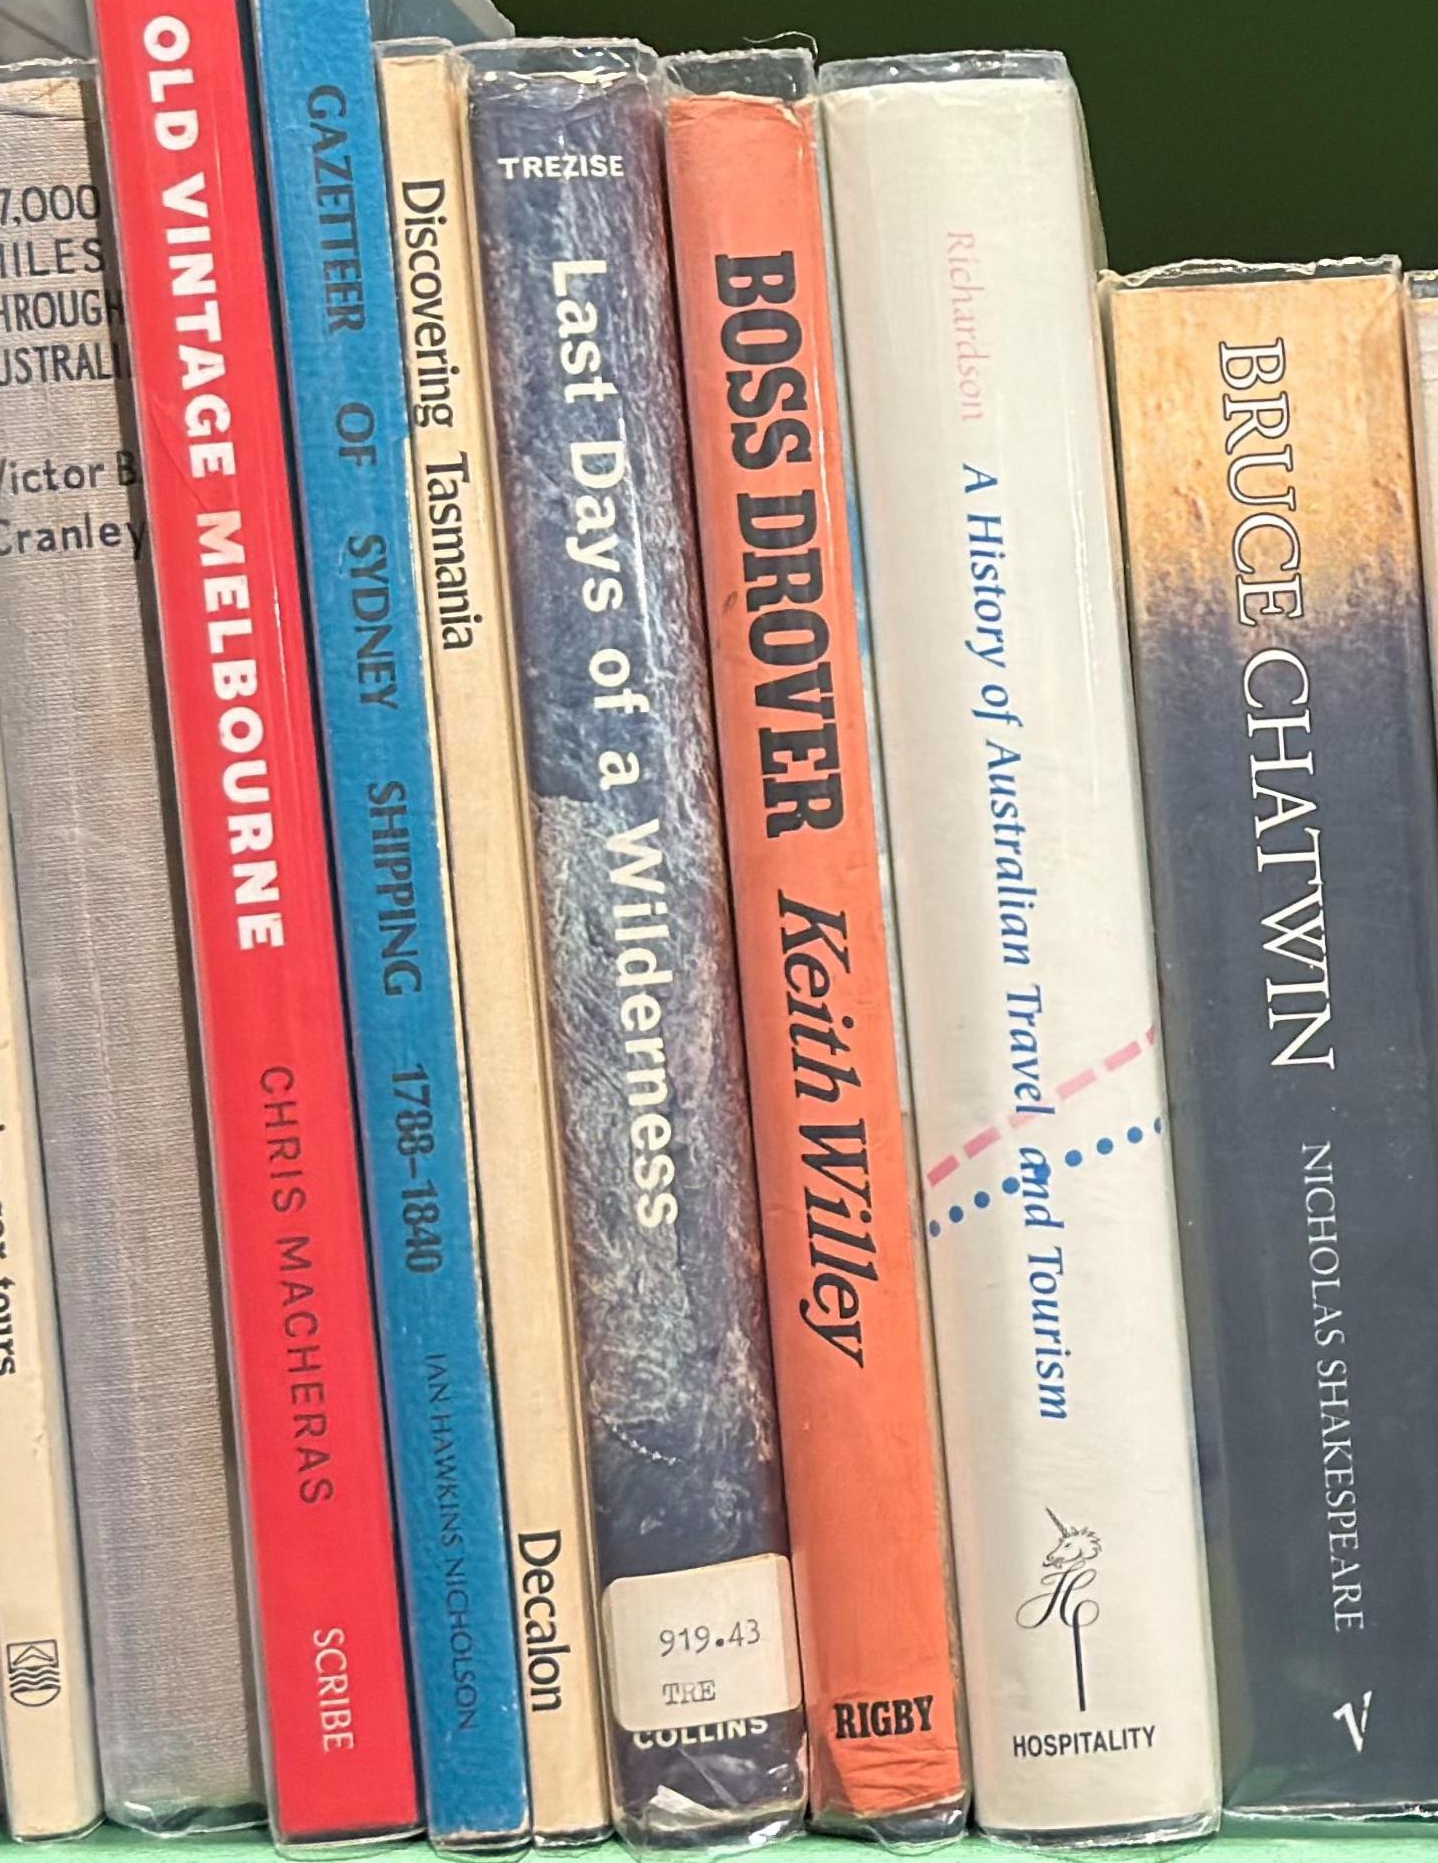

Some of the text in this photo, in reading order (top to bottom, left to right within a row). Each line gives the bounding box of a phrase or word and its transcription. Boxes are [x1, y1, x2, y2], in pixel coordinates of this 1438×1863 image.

[497, 154, 625, 181] TREZISE
[143, 14, 285, 952] OLD VINTAGE MELBOURNE
[306, 83, 424, 999] GAZETTEER OF SYDNEY SHIPPING
[401, 179, 483, 651] Discovering Tasmania
[551, 259, 680, 1231] Last Days of a Wilderness
[714, 250, 880, 1369] BOSS DROVER Keith Willey
[946, 231, 1070, 1421] Richardson A History of Australian Travel and Tourism
[1218, 336, 1336, 1071] BRUCE CHATWIN
[260, 1065, 335, 1506] CHRIS MACHERAS
[1299, 1140, 1366, 1632] NICHOLAS SHAKESPEARE
[312, 1627, 355, 1753] SCRIBE
[422, 1353, 479, 1731] IAN HAWKINS NICHOLSON
[518, 1530, 571, 1713] Decalon
[633, 1715, 769, 1749] COLLINS
[659, 1618, 761, 1657] 919.43
[662, 1679, 716, 1705] TRE
[833, 1693, 936, 1740] RIGBY
[1012, 1724, 1156, 1758] HOSPITALITY
